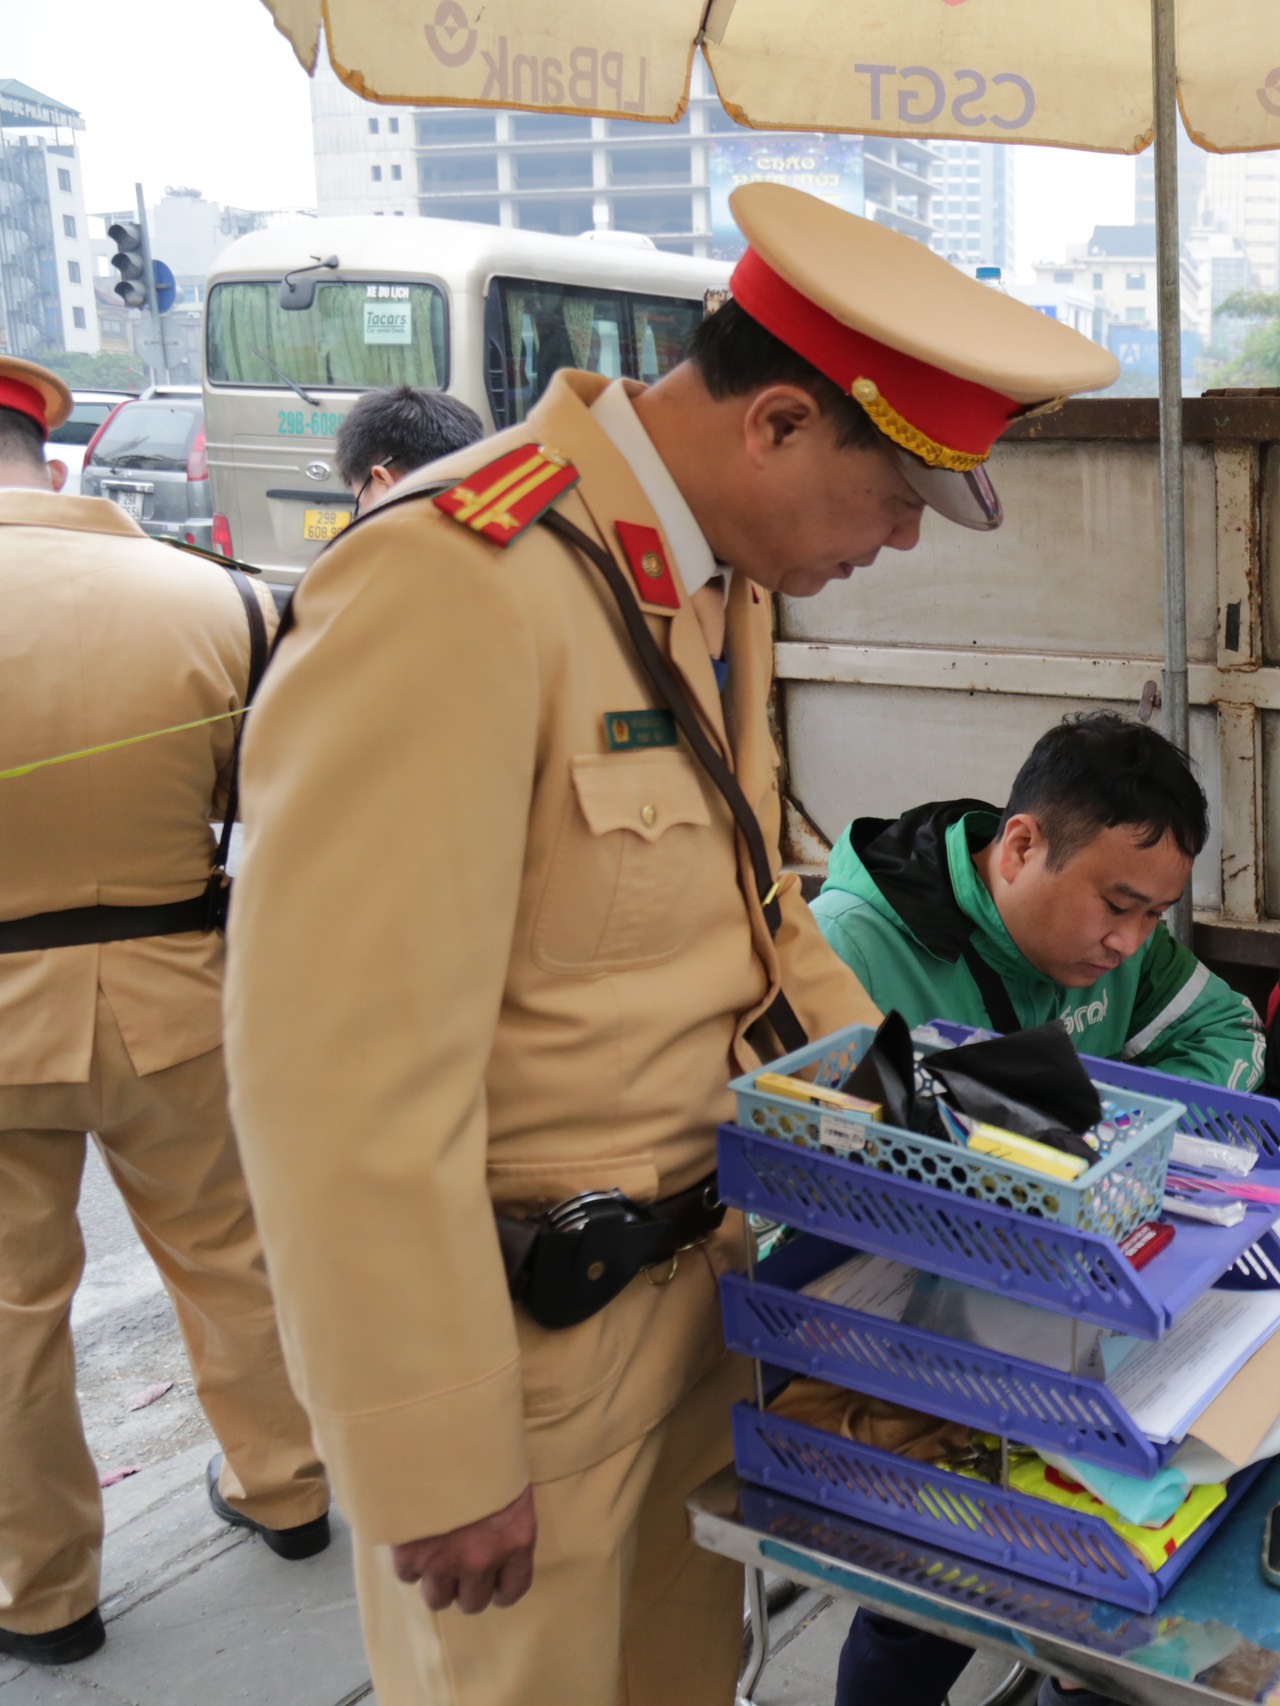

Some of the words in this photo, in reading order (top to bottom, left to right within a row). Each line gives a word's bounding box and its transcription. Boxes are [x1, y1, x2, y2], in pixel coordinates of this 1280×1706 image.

[366, 285, 378, 298] XE
[367, 311, 407, 325] Tacars
[317, 511, 337, 525] 29B
